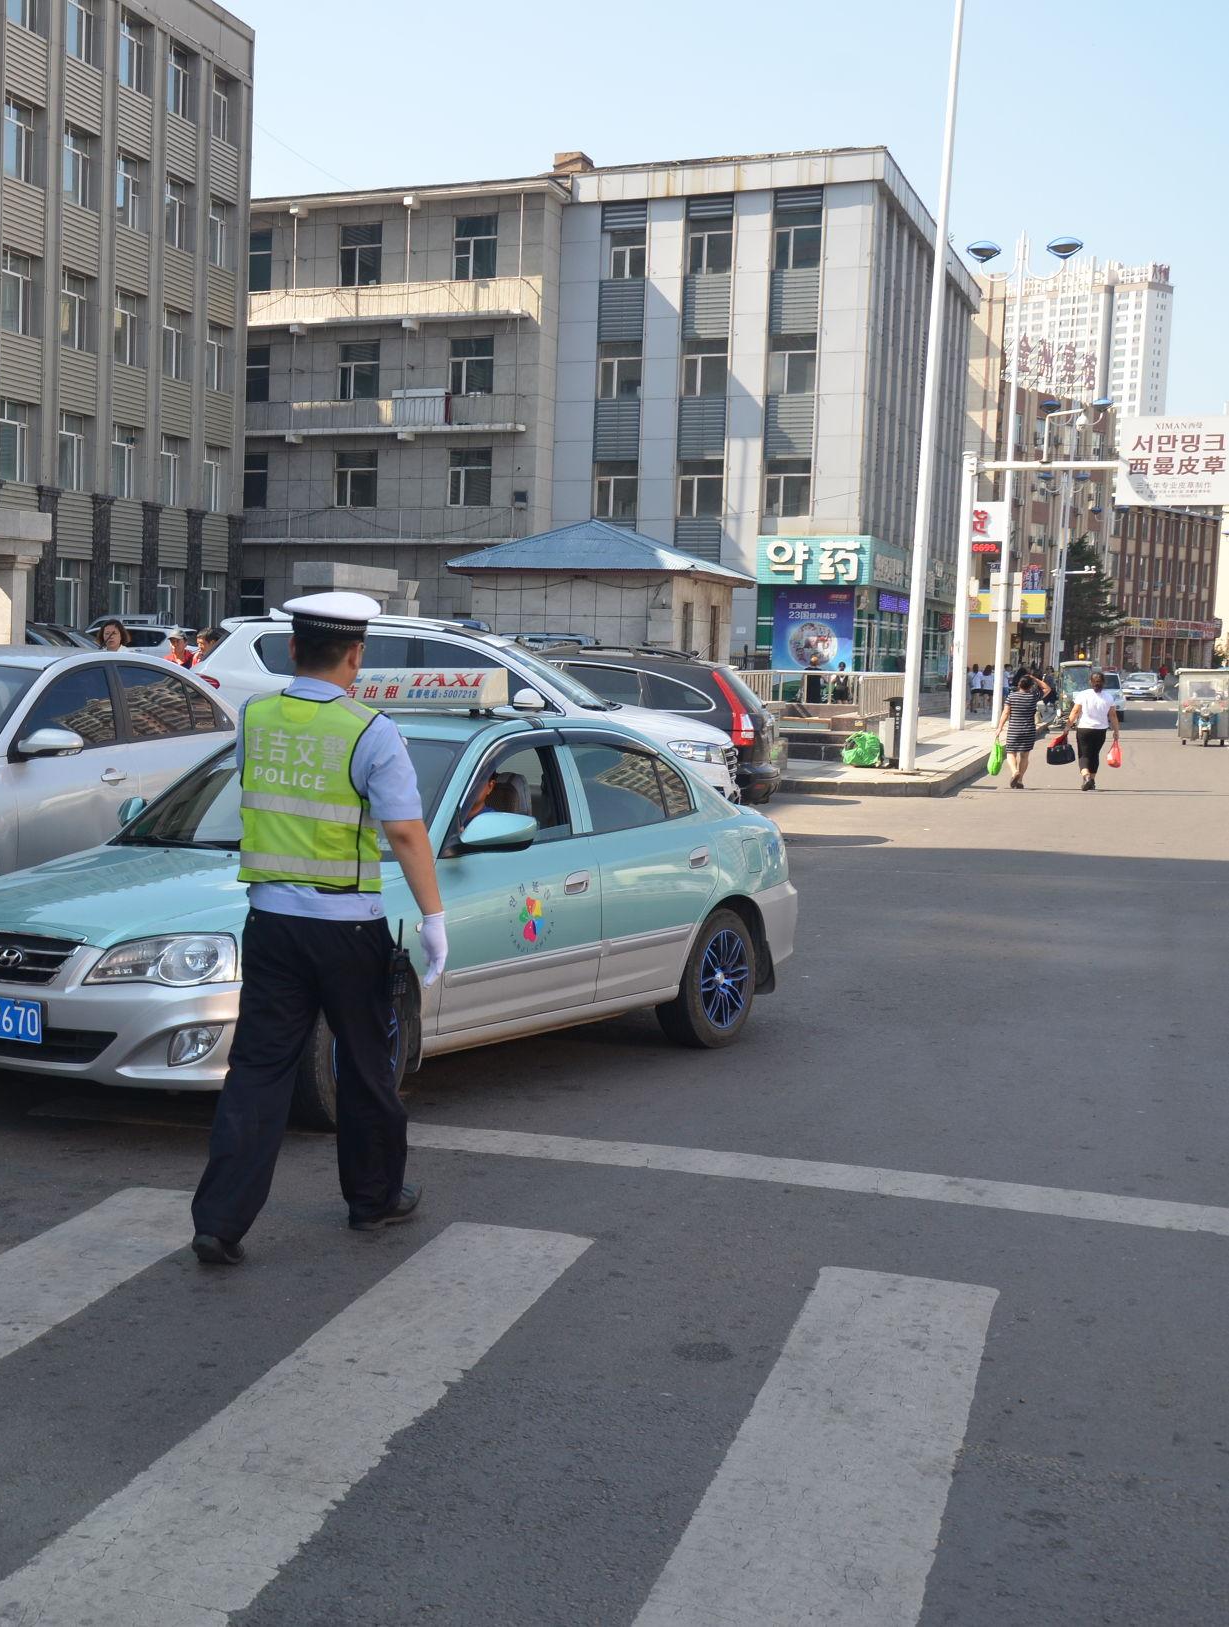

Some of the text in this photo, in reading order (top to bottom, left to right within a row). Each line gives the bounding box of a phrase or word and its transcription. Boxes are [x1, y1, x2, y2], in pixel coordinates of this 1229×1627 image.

[1156, 422, 1187, 430] XIMAN
[1132, 434, 1226, 453] 서만밍크
[1128, 456, 1226, 475] 西曼皮草
[766, 541, 809, 581] 약
[818, 540, 862, 581] 药
[411, 673, 486, 687] TAXI
[248, 727, 347, 774] 延吉交警
[253, 765, 326, 792] POLICE
